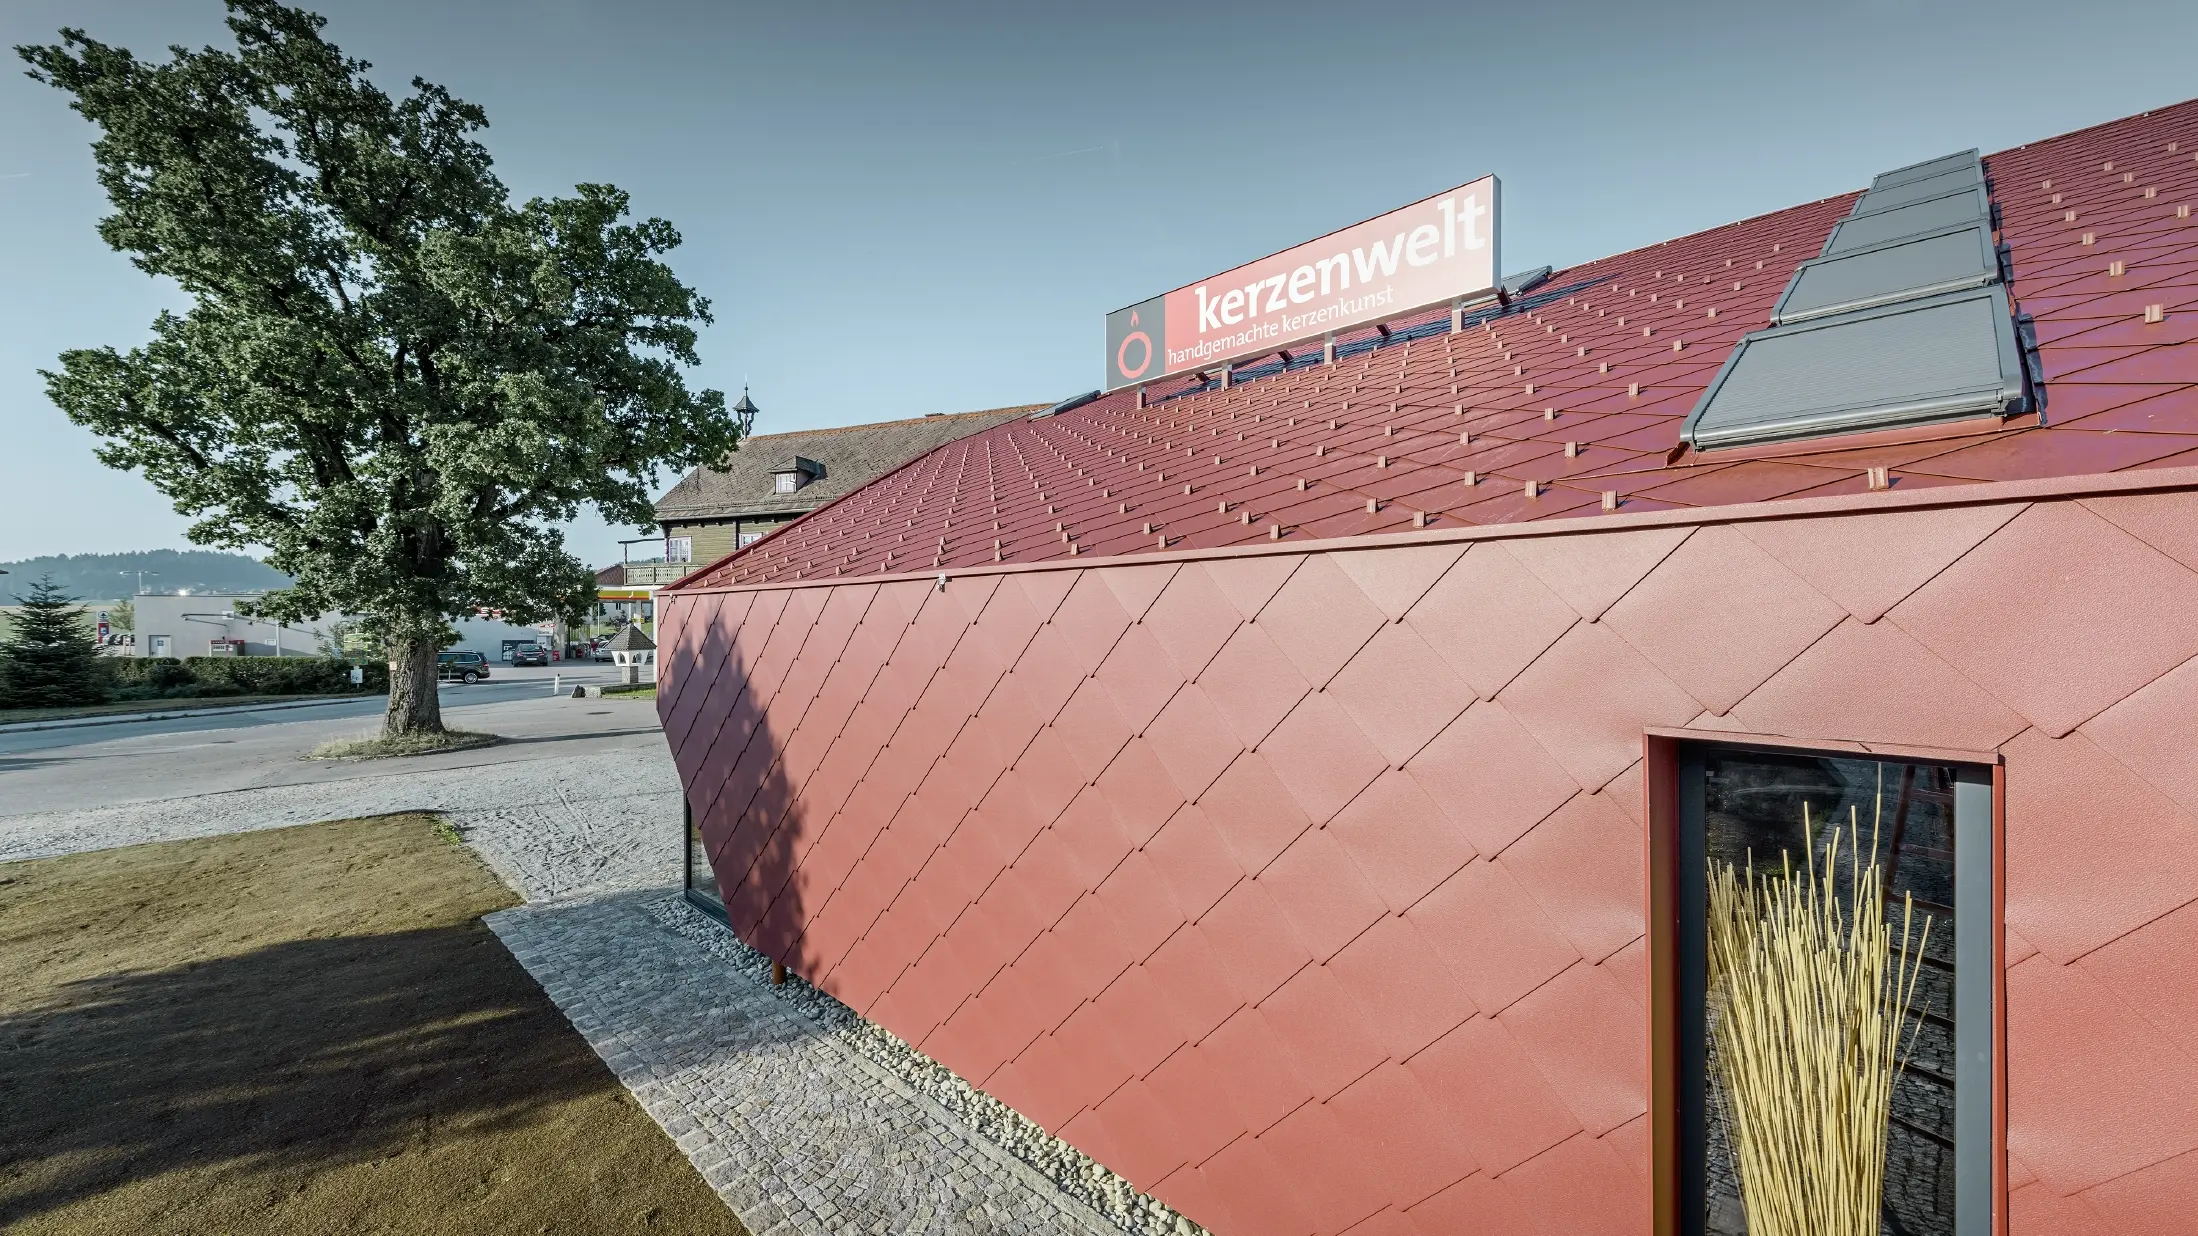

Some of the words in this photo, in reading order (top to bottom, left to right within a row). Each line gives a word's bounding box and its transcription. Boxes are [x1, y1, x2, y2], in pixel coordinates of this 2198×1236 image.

[1194, 193, 1487, 334] kerzenwelt
[1167, 321, 1279, 366] handgemachte
[1281, 284, 1394, 333] kerzenkunst
